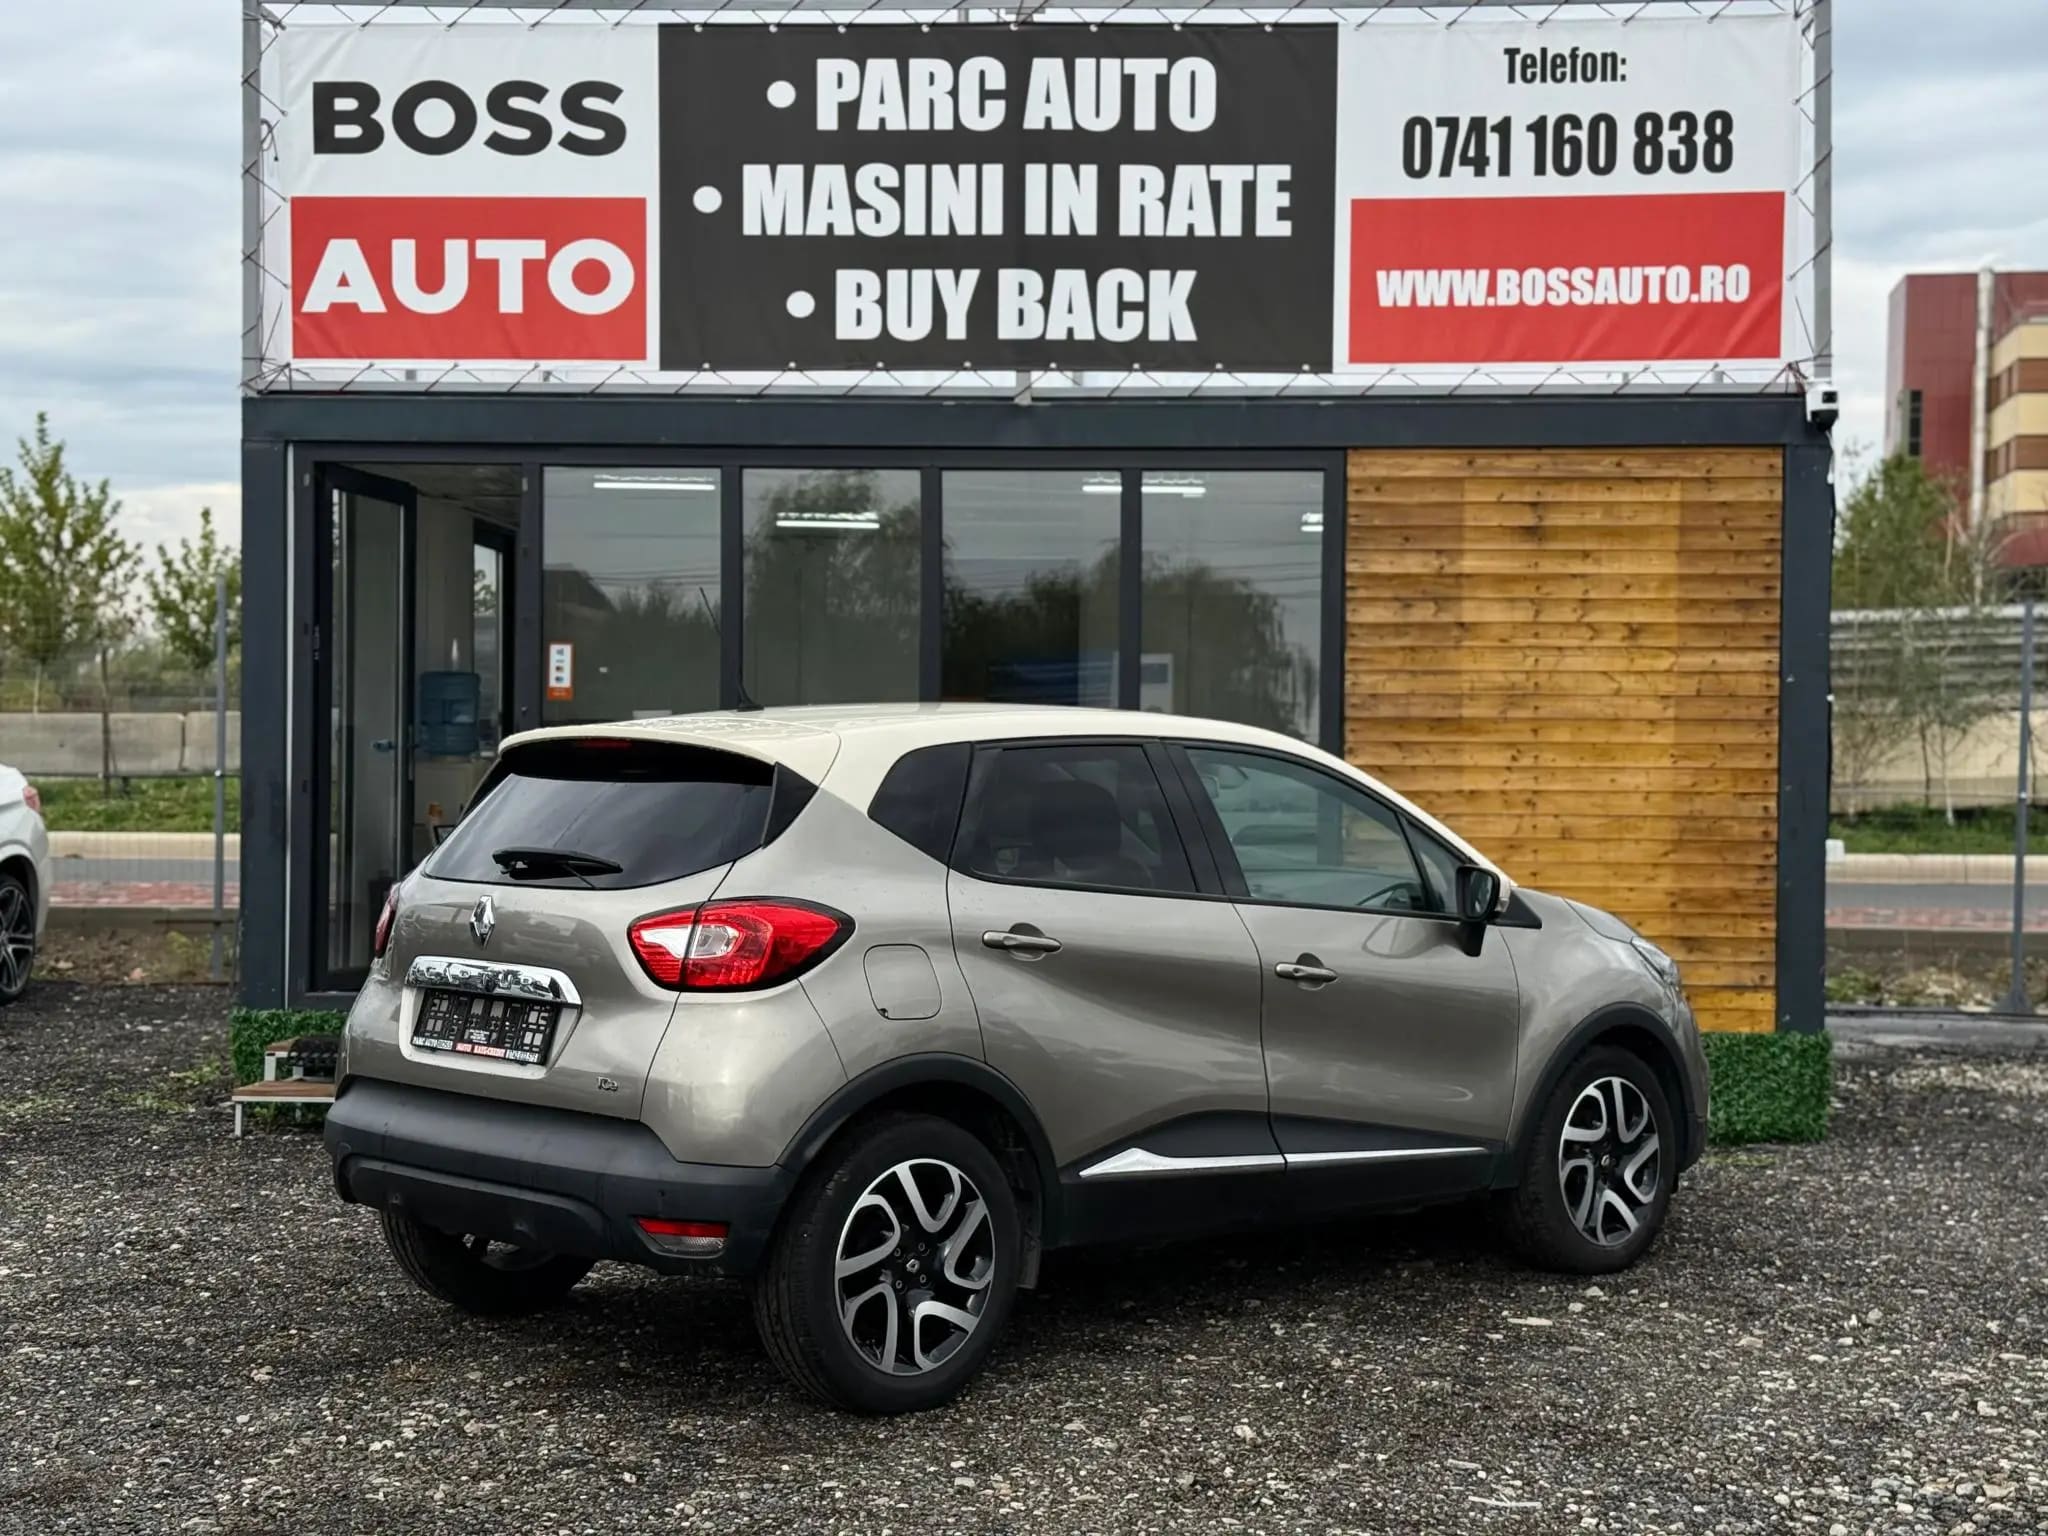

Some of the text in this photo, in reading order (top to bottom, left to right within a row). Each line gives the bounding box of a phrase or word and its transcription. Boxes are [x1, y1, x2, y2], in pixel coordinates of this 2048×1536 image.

[816, 56, 1217, 132] PARC AUTO
[1504, 47, 1627, 84] Telefon:
[313, 80, 627, 156] BOSS
[1402, 110, 1734, 179] 0741 160 838
[742, 163, 1292, 237] MASINI IN RATE
[301, 238, 635, 316] AUTO
[835, 268, 1198, 342] BUY BACK
[1376, 263, 1751, 308] WWW.BOSSAUTO.RO
